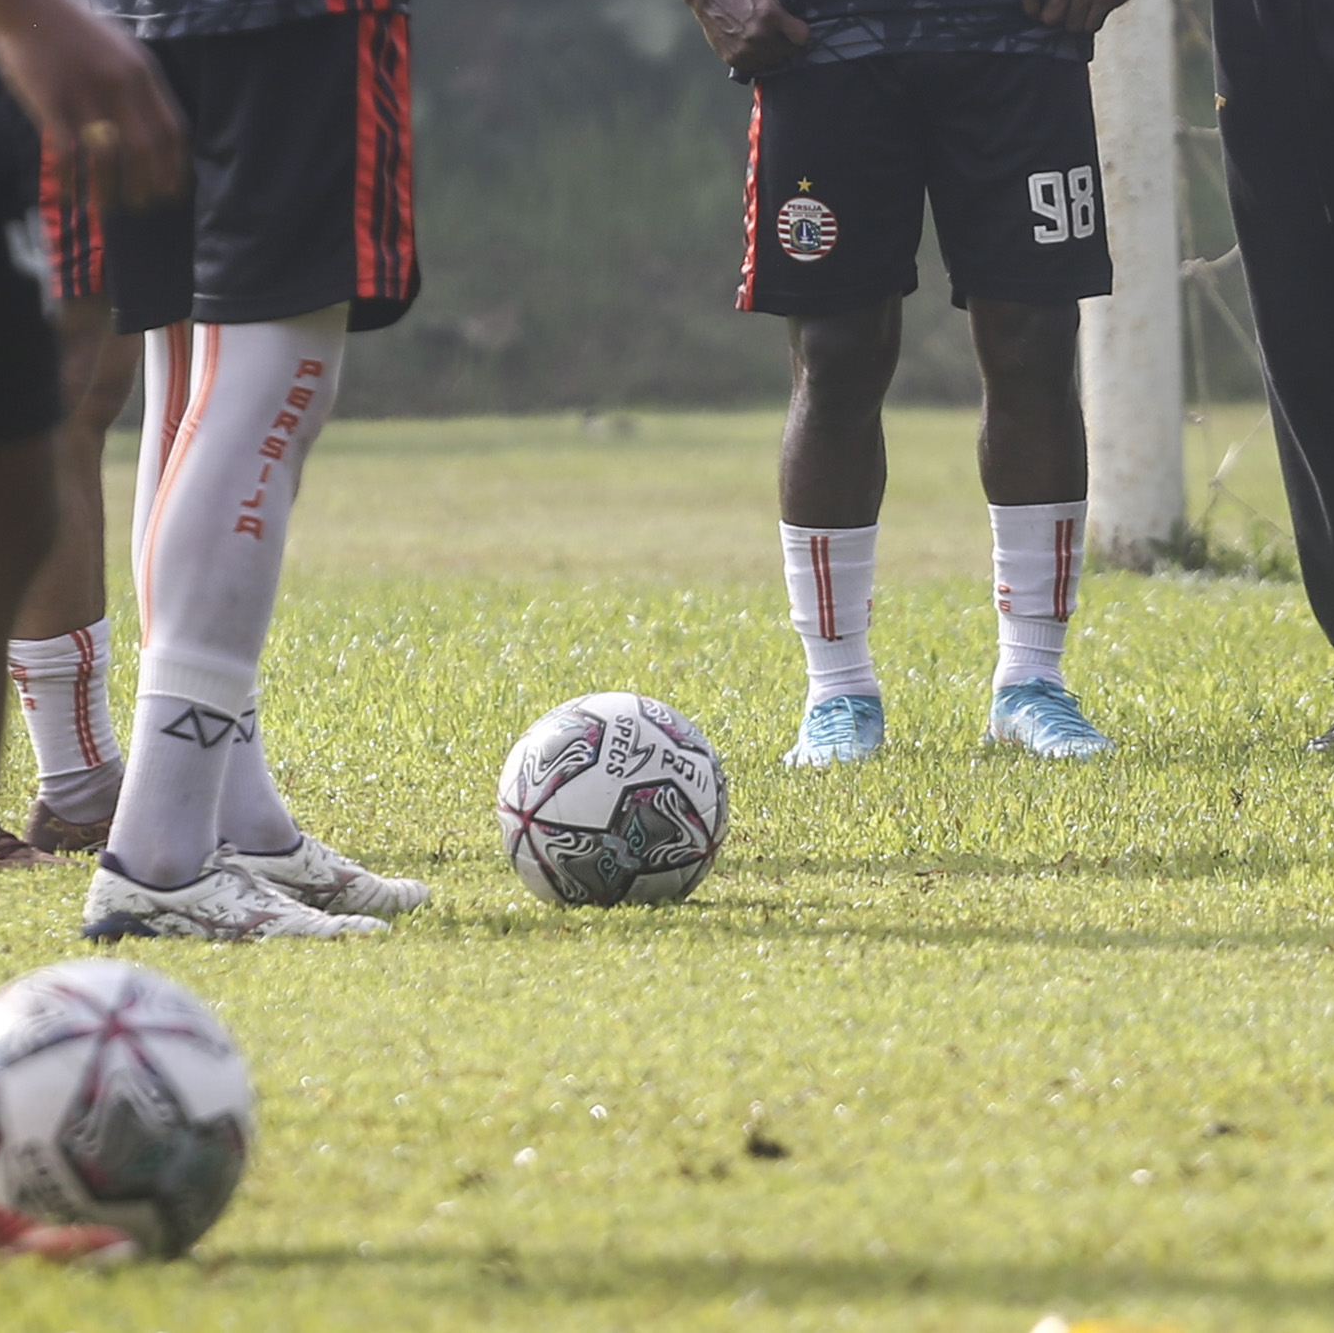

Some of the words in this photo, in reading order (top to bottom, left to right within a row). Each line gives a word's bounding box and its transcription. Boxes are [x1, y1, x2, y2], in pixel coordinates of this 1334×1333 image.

[787, 204, 822, 212] PERSIJA
[1028, 165, 1095, 244] 98
[233, 358, 324, 542] PERSIJA
[606, 714, 634, 779] SPECS
